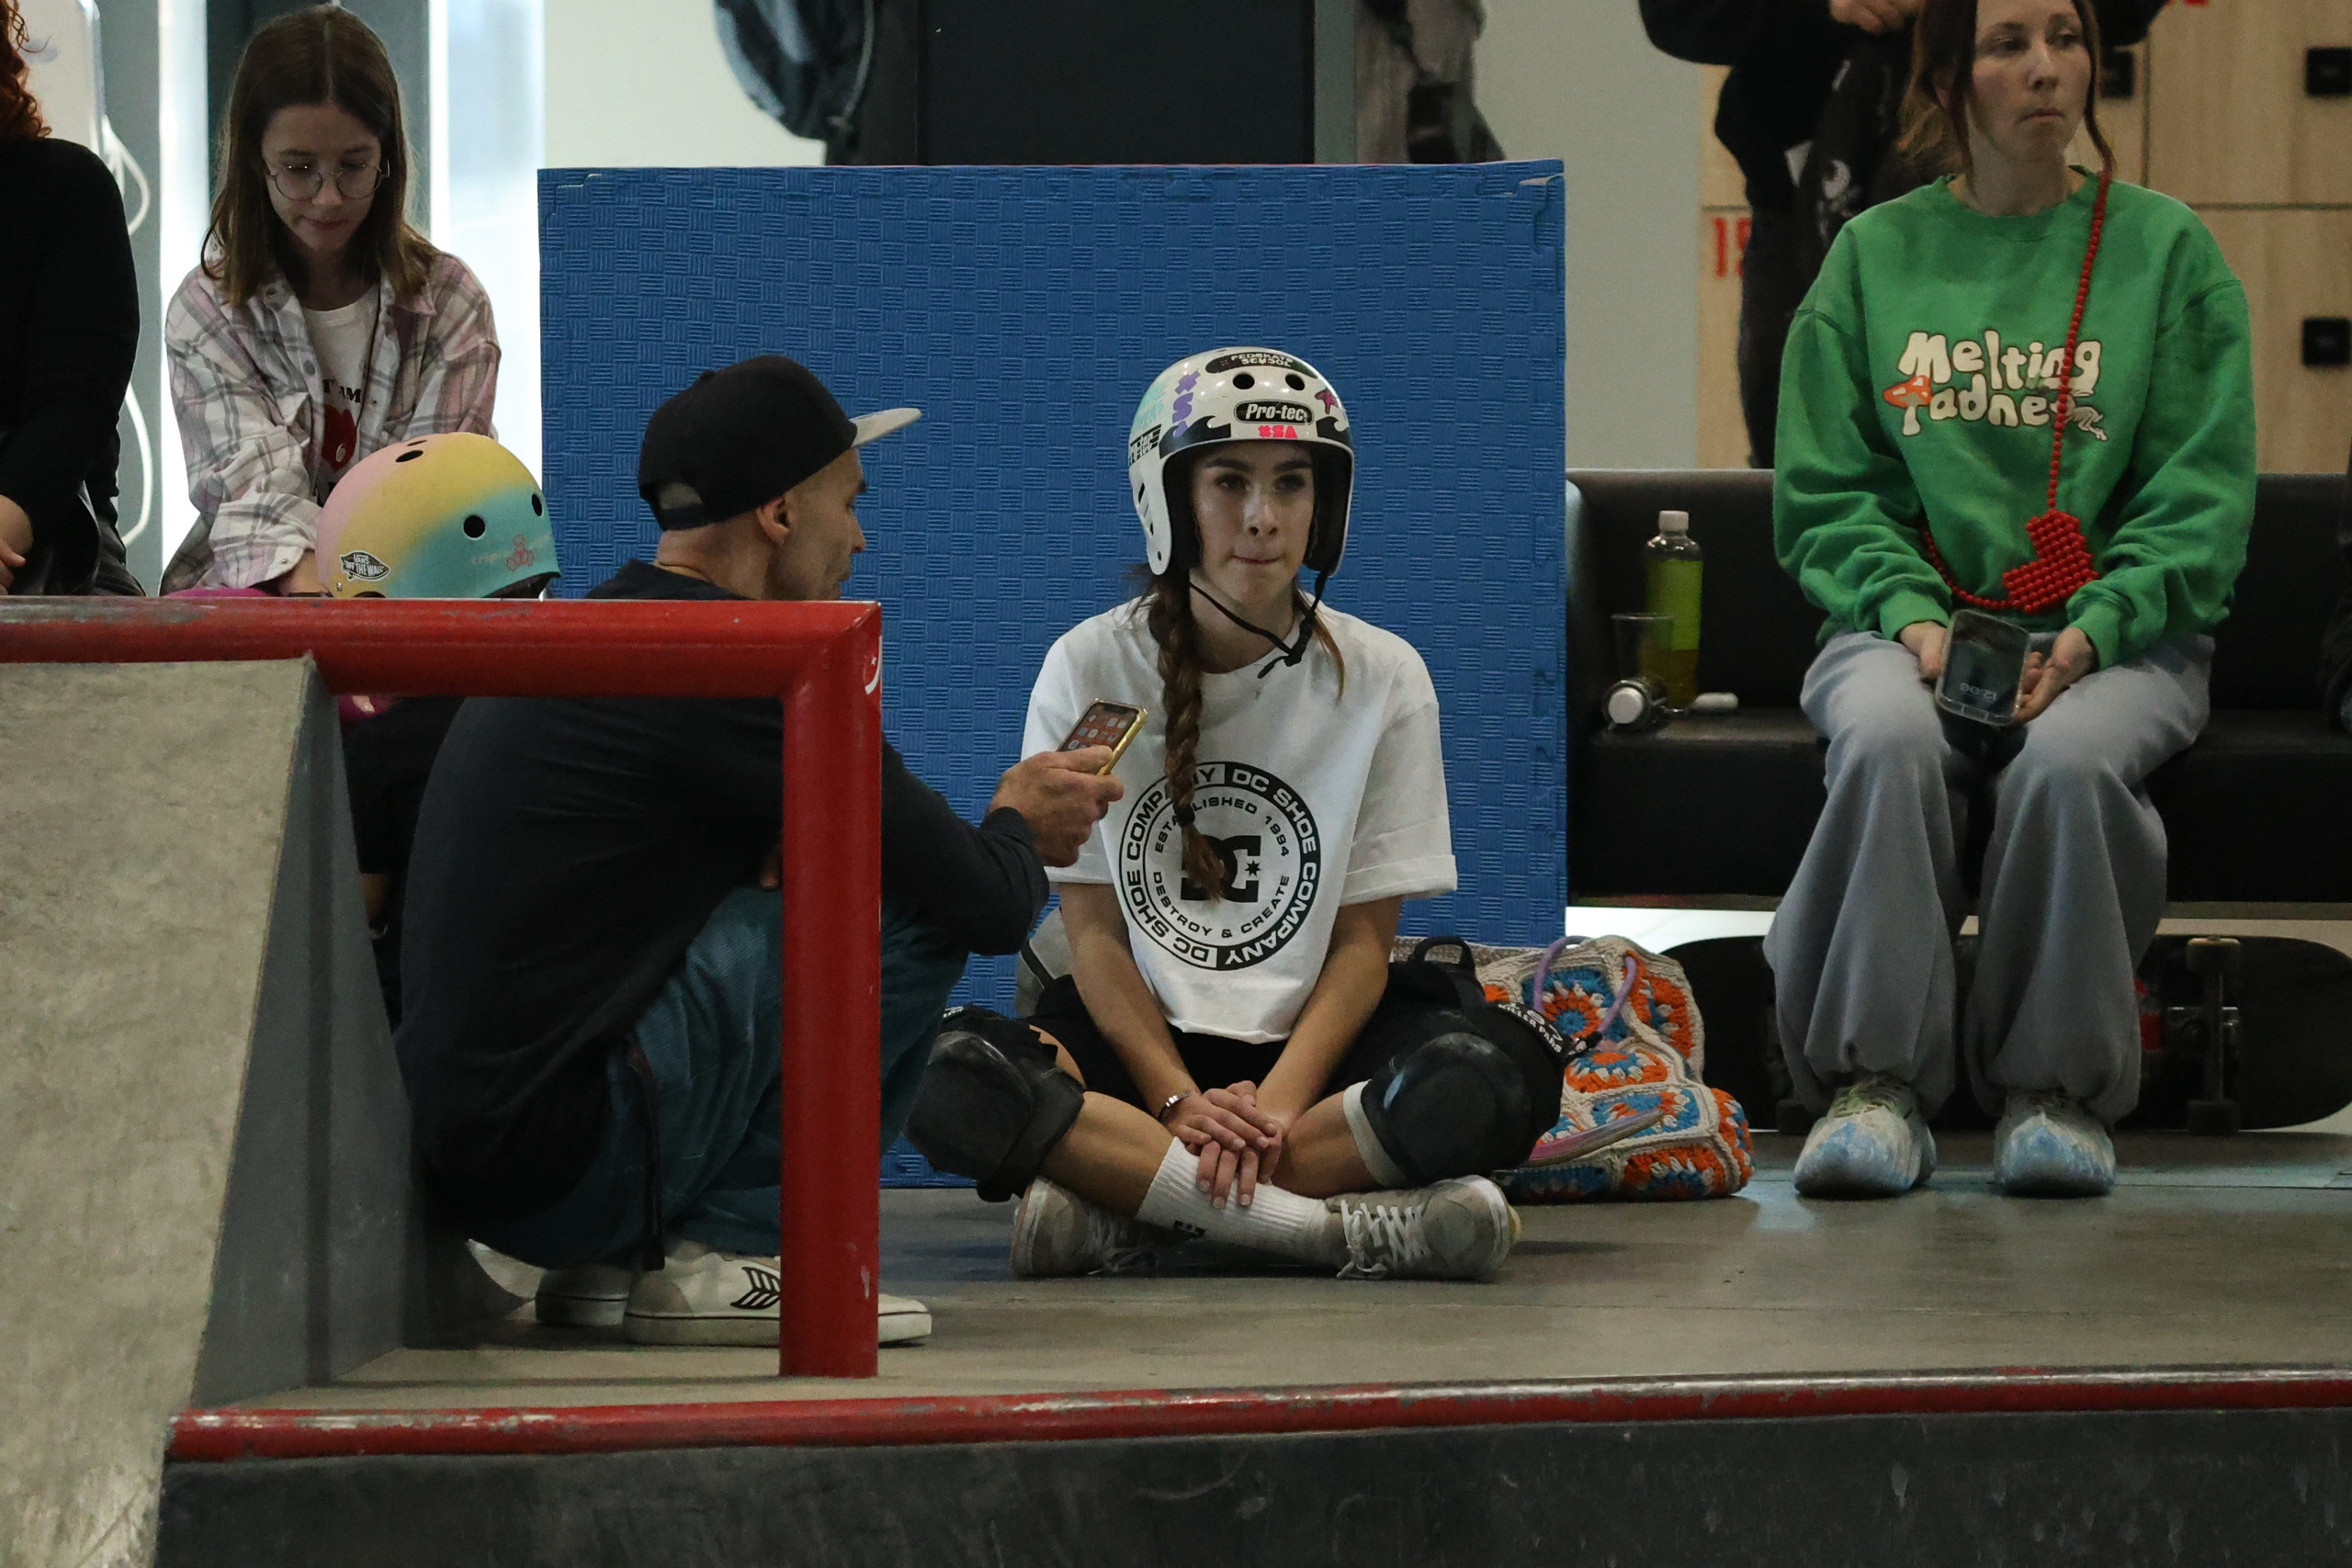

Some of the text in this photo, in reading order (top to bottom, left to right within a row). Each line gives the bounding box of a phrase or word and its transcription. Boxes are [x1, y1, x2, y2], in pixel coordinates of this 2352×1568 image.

[1897, 328, 2101, 392] Melting
[1245, 403, 1306, 421] Pro-tec
[1155, 796, 1257, 853] ESTALISHED
[1127, 767, 1216, 963] DC SHOE COMPY
[1225, 769, 1317, 964] DC SHOE COMPANY
[1153, 872, 1290, 938] DESTROY & CREATE
[1539, 1025, 1562, 1053] PADS
